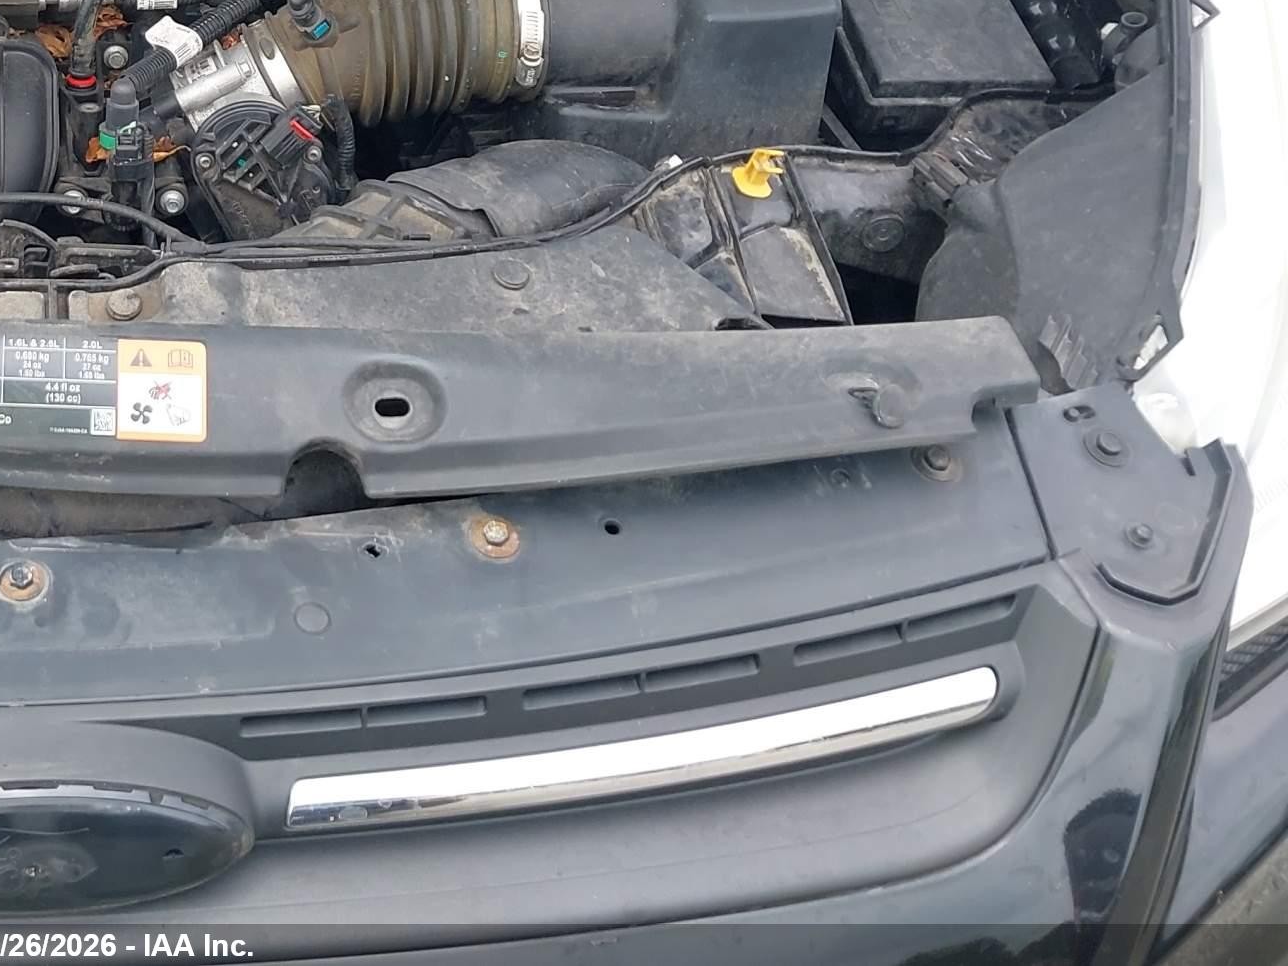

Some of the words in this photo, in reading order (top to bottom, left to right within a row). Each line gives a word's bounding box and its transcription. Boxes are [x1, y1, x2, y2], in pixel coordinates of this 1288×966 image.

[82, 340, 103, 349] 2.0L
[39, 351, 50, 363] kg
[98, 354, 109, 365] kg
[45, 383, 59, 392] 4.4
[69, 385, 81, 393] oz
[45, 393, 66, 403] (130
[67, 393, 82, 404] cc)
